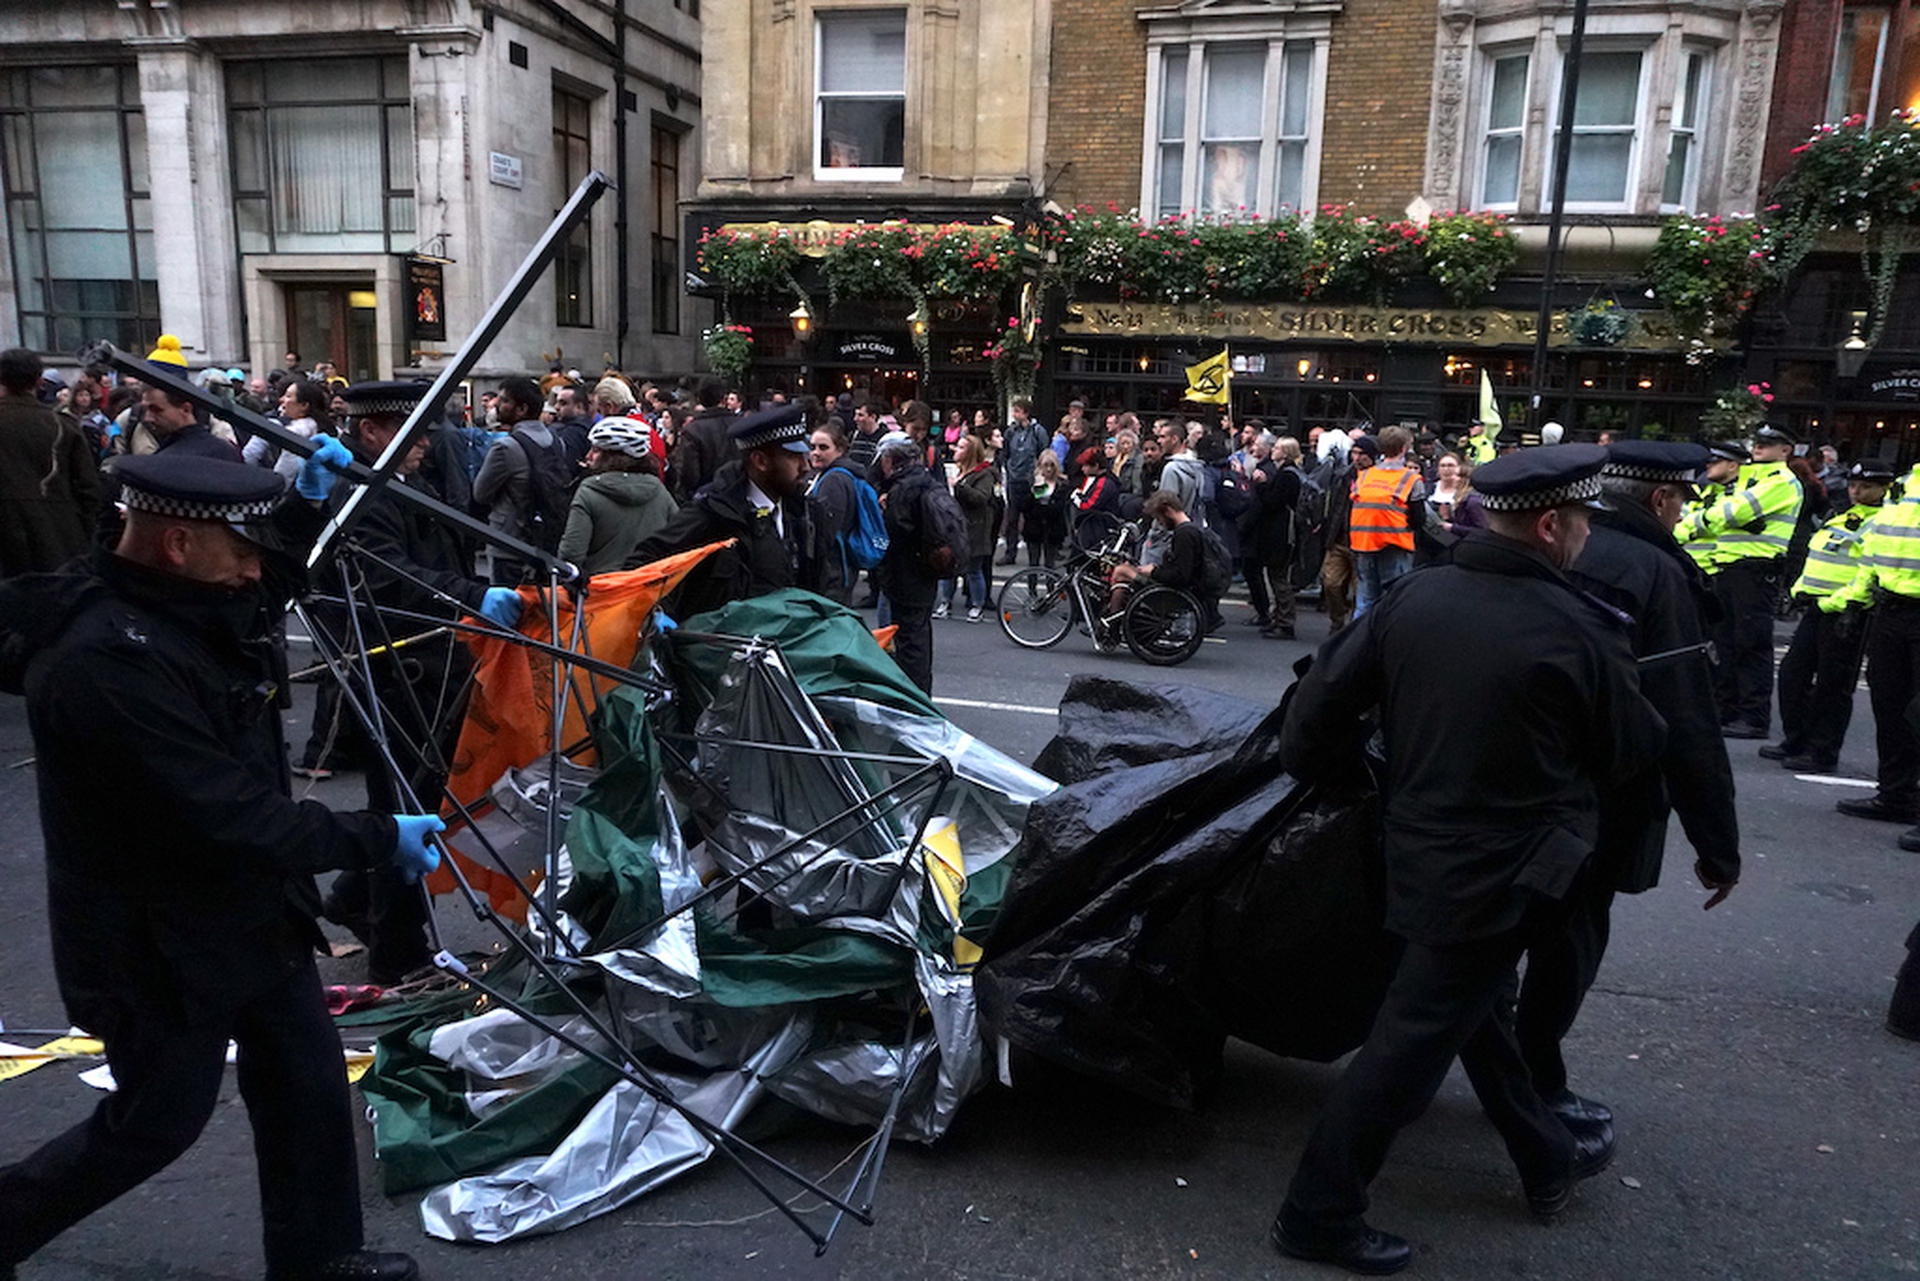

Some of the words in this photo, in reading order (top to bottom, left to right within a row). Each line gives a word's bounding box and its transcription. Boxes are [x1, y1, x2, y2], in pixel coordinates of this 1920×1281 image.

[1279, 311, 1378, 333] SILVER
[1388, 314, 1488, 336] CROSS
[840, 342, 867, 354] SILVER
[868, 343, 895, 355] CROSS
[1870, 378, 1908, 392] SILVER
